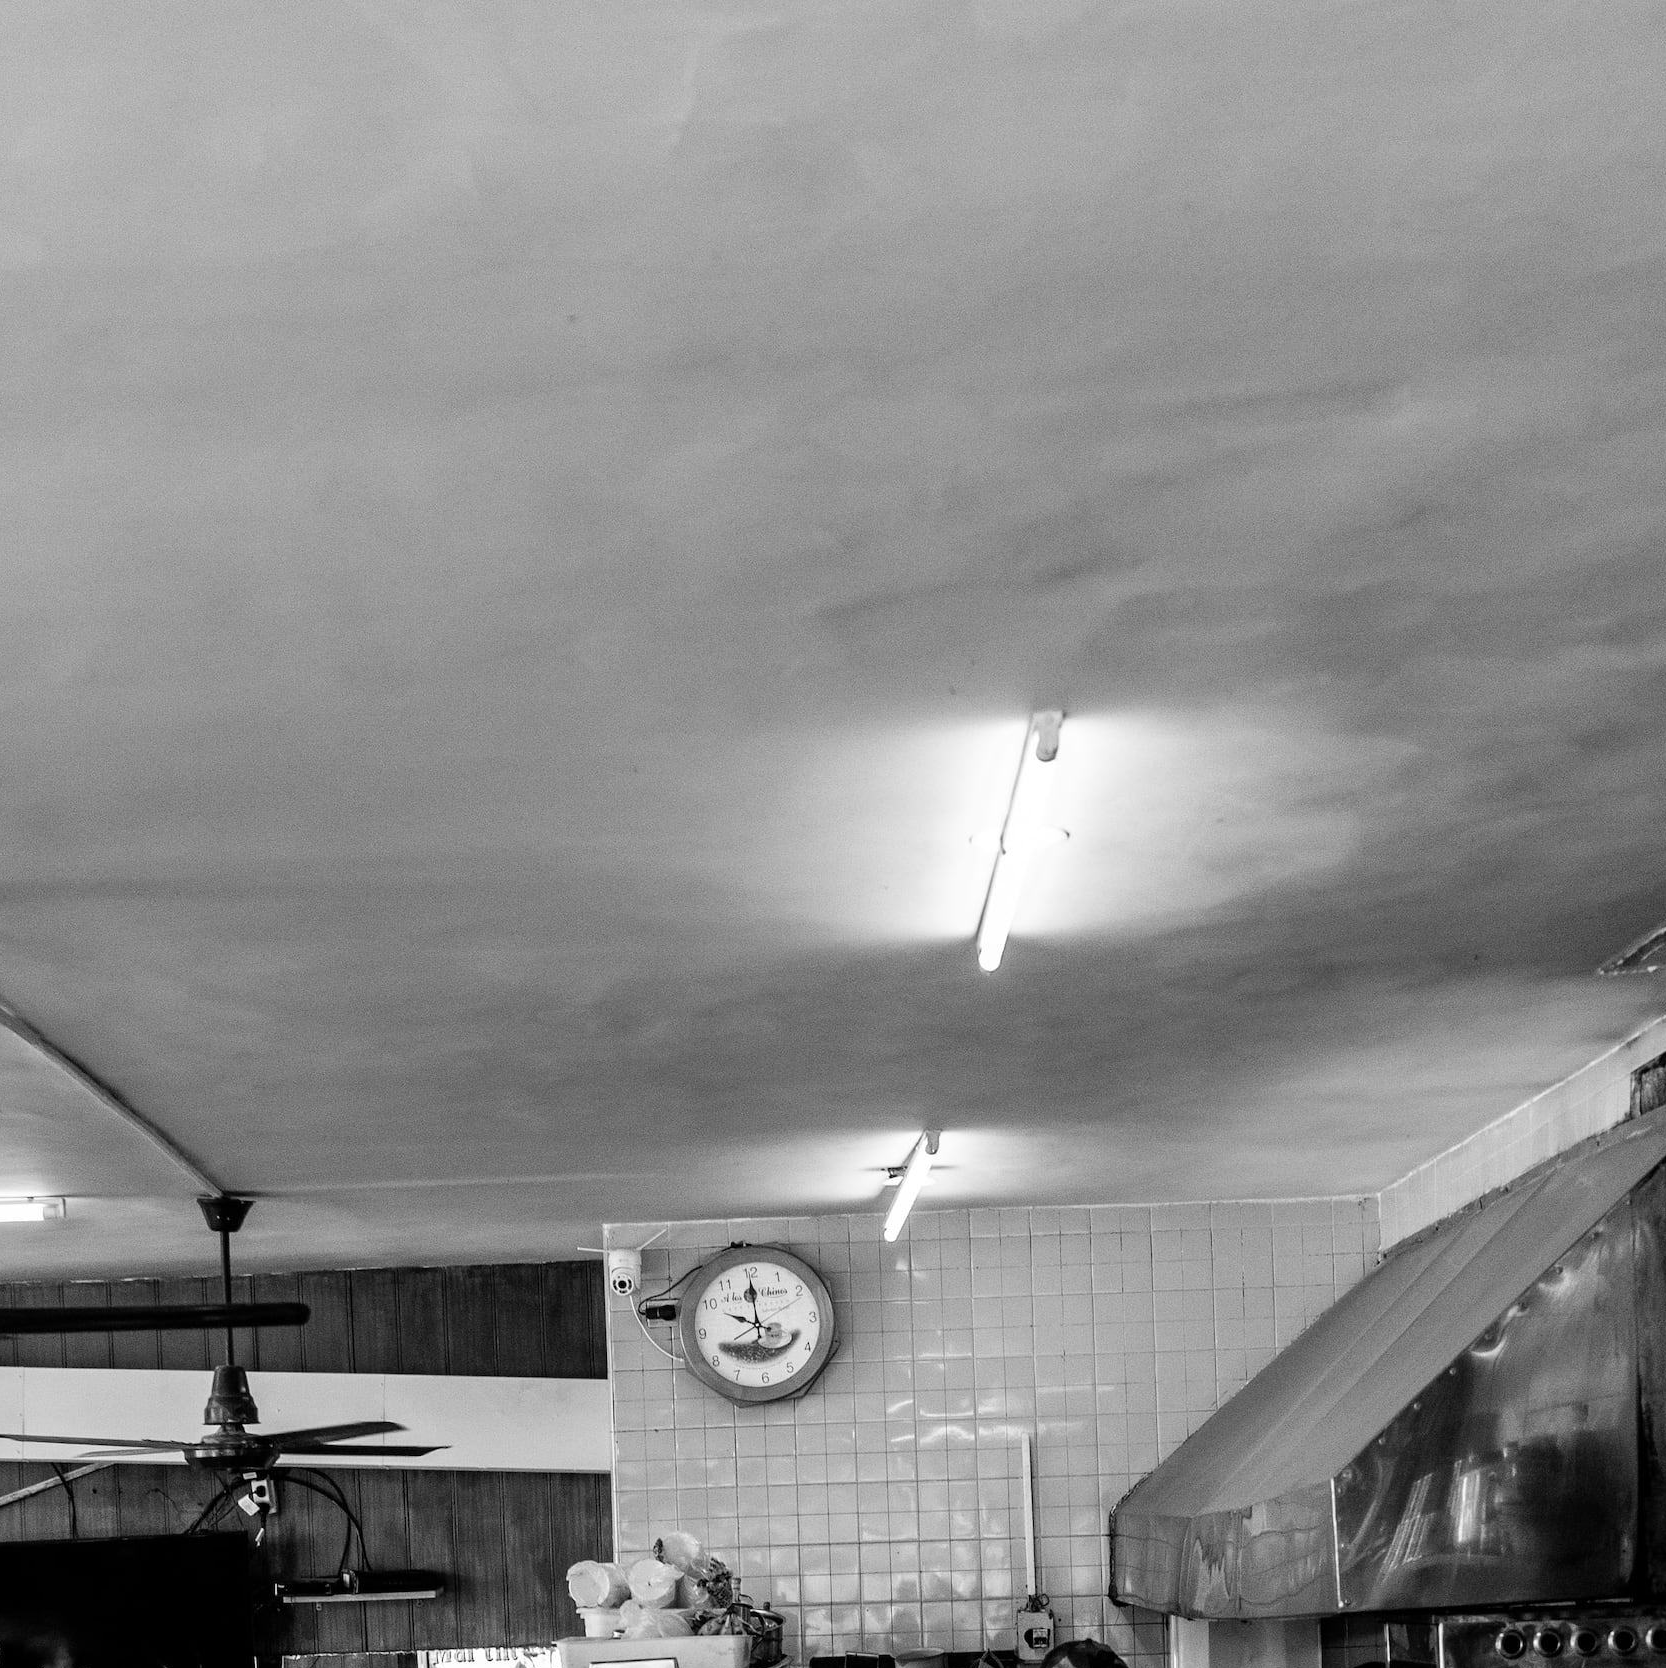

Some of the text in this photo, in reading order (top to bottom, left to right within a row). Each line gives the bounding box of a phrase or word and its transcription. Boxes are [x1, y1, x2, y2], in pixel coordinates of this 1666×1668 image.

[744, 1267, 758, 1279] 12
[775, 1271, 780, 1282] 1
[719, 1279, 731, 1291] 11
[795, 1285, 803, 1297] 2
[703, 1298, 718, 1310] 10
[808, 1311, 817, 1323] 3
[698, 1328, 707, 1339] 9
[804, 1341, 811, 1352] 4
[712, 1355, 720, 1367] 8
[786, 1361, 794, 1373] 5
[733, 1369, 741, 1381] 7
[761, 1371, 770, 1384] 6
